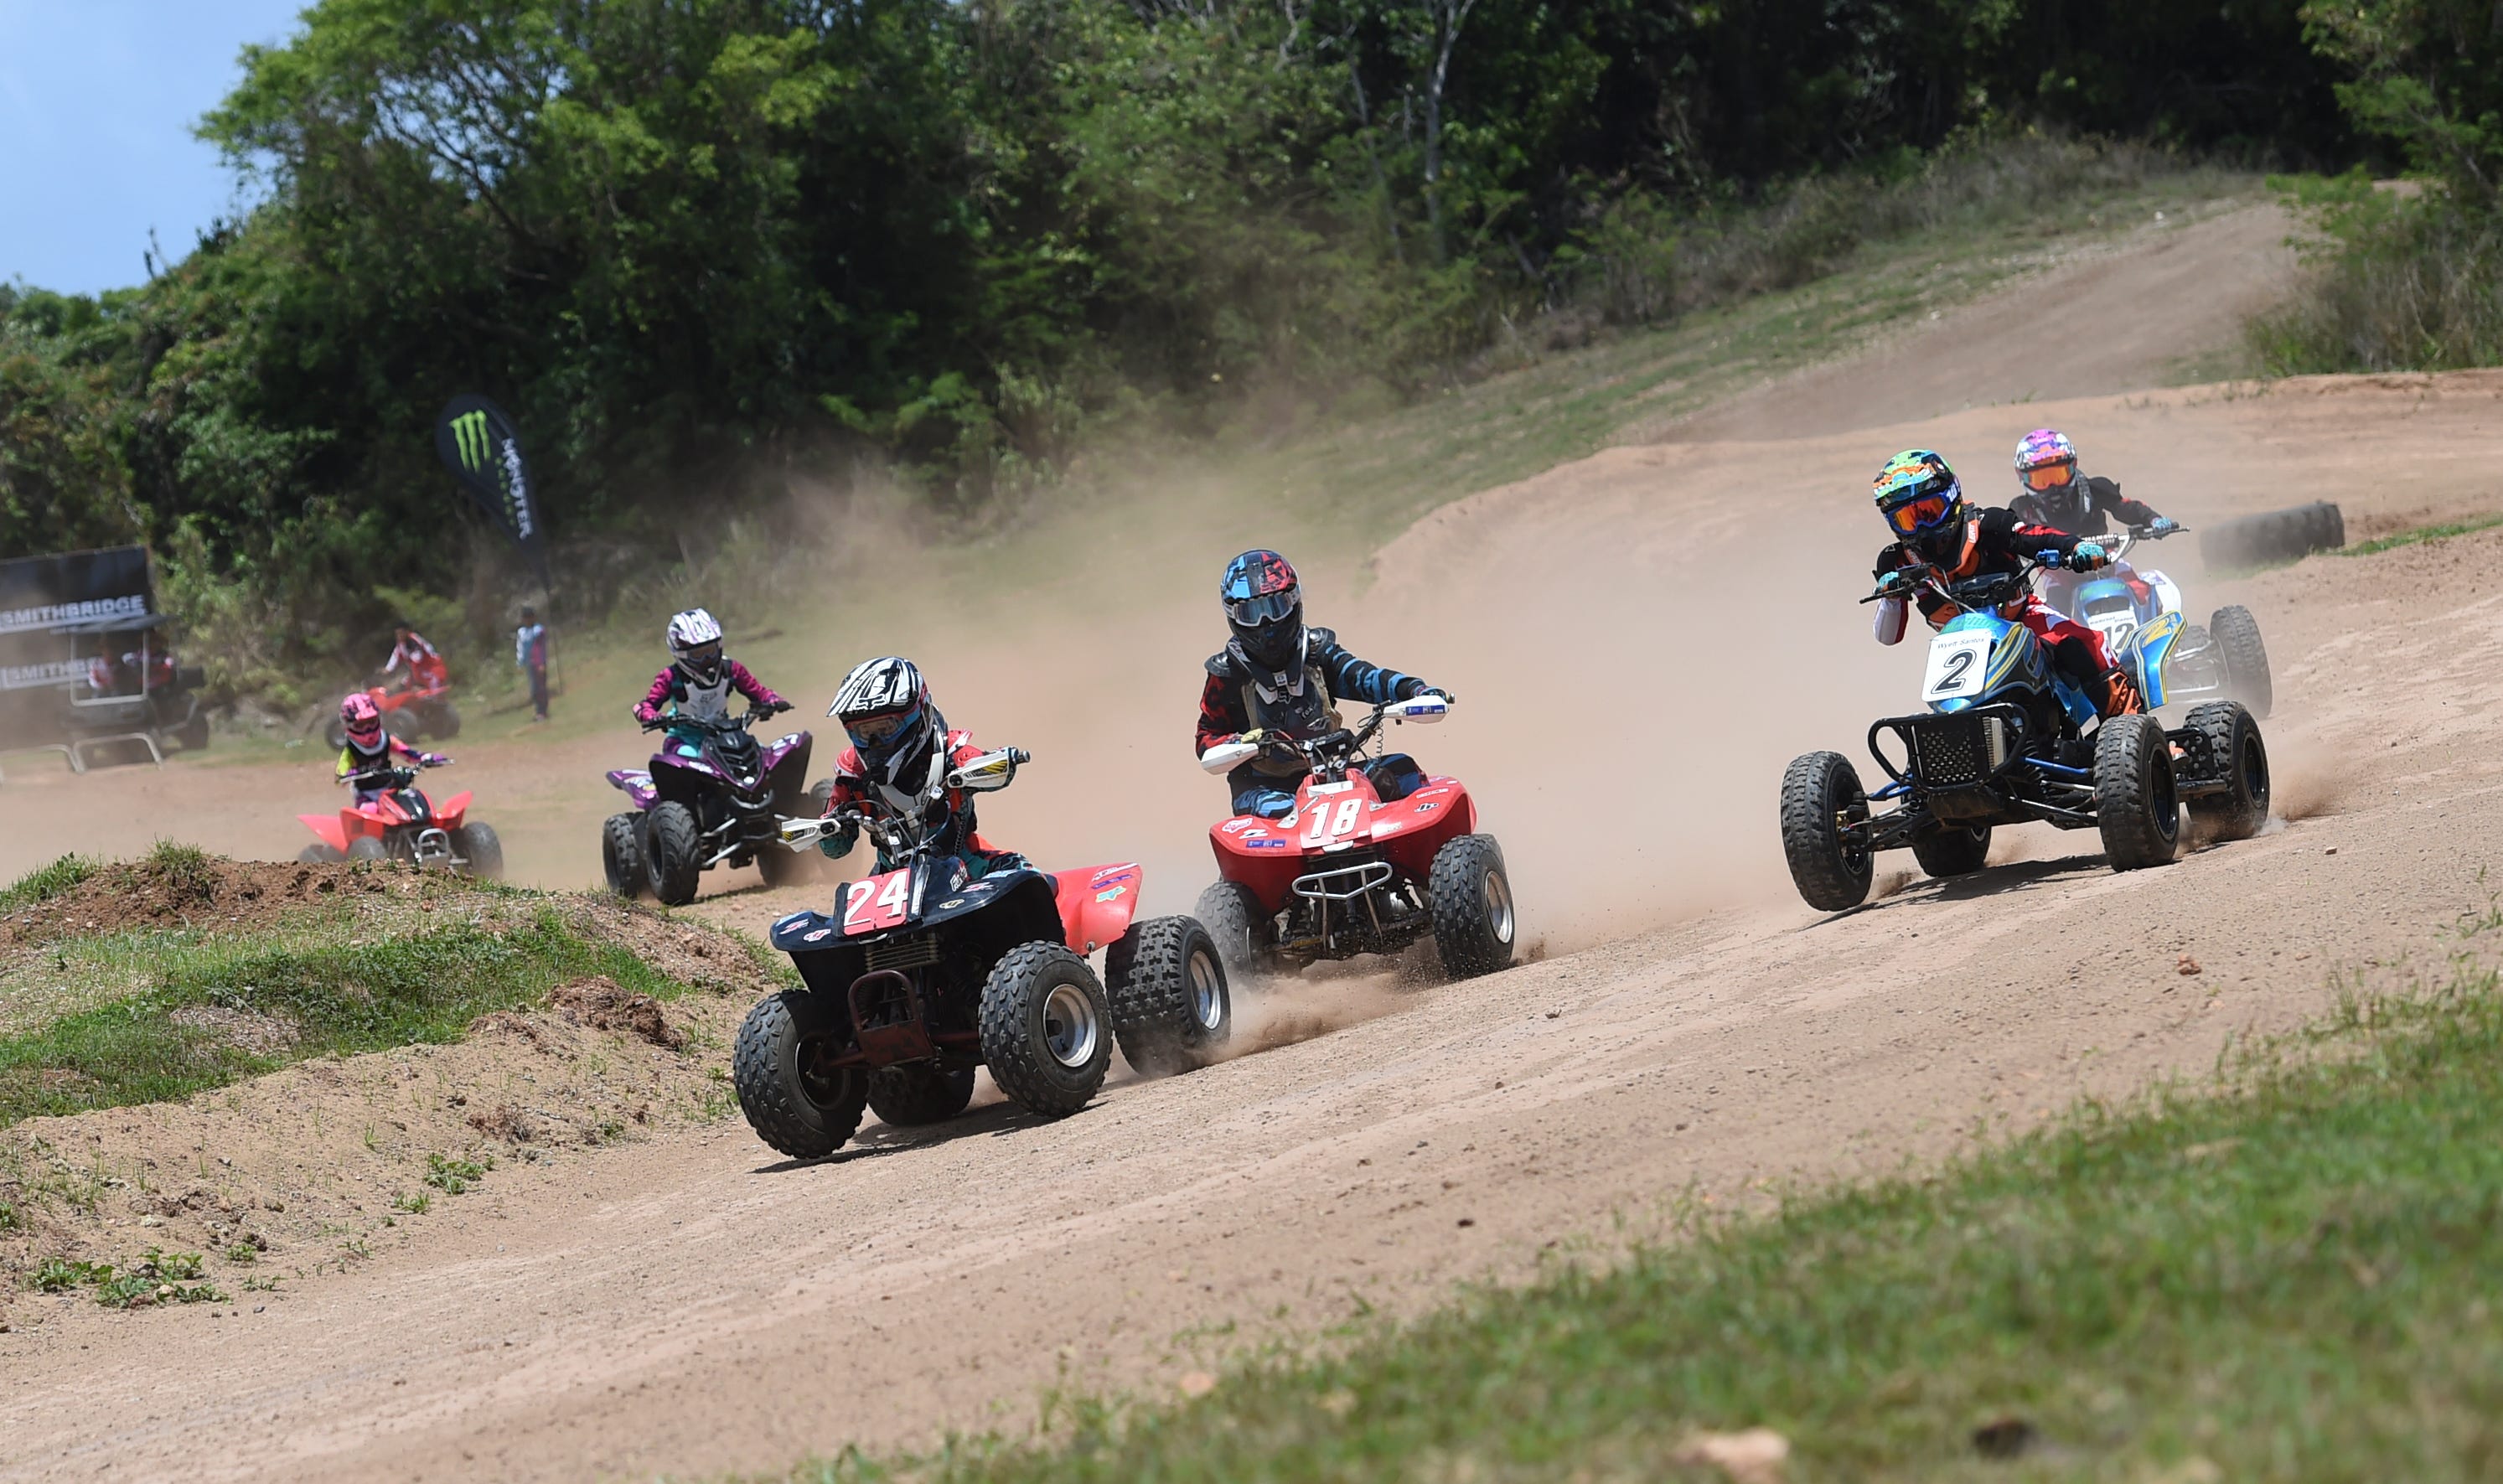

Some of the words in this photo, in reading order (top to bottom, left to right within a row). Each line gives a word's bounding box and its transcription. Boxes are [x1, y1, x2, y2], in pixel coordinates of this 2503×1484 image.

[0, 594, 145, 626] SMITHBRIDGE
[1931, 649, 1977, 694] 2
[1310, 799, 1363, 839] 18
[844, 871, 908, 926] 24
